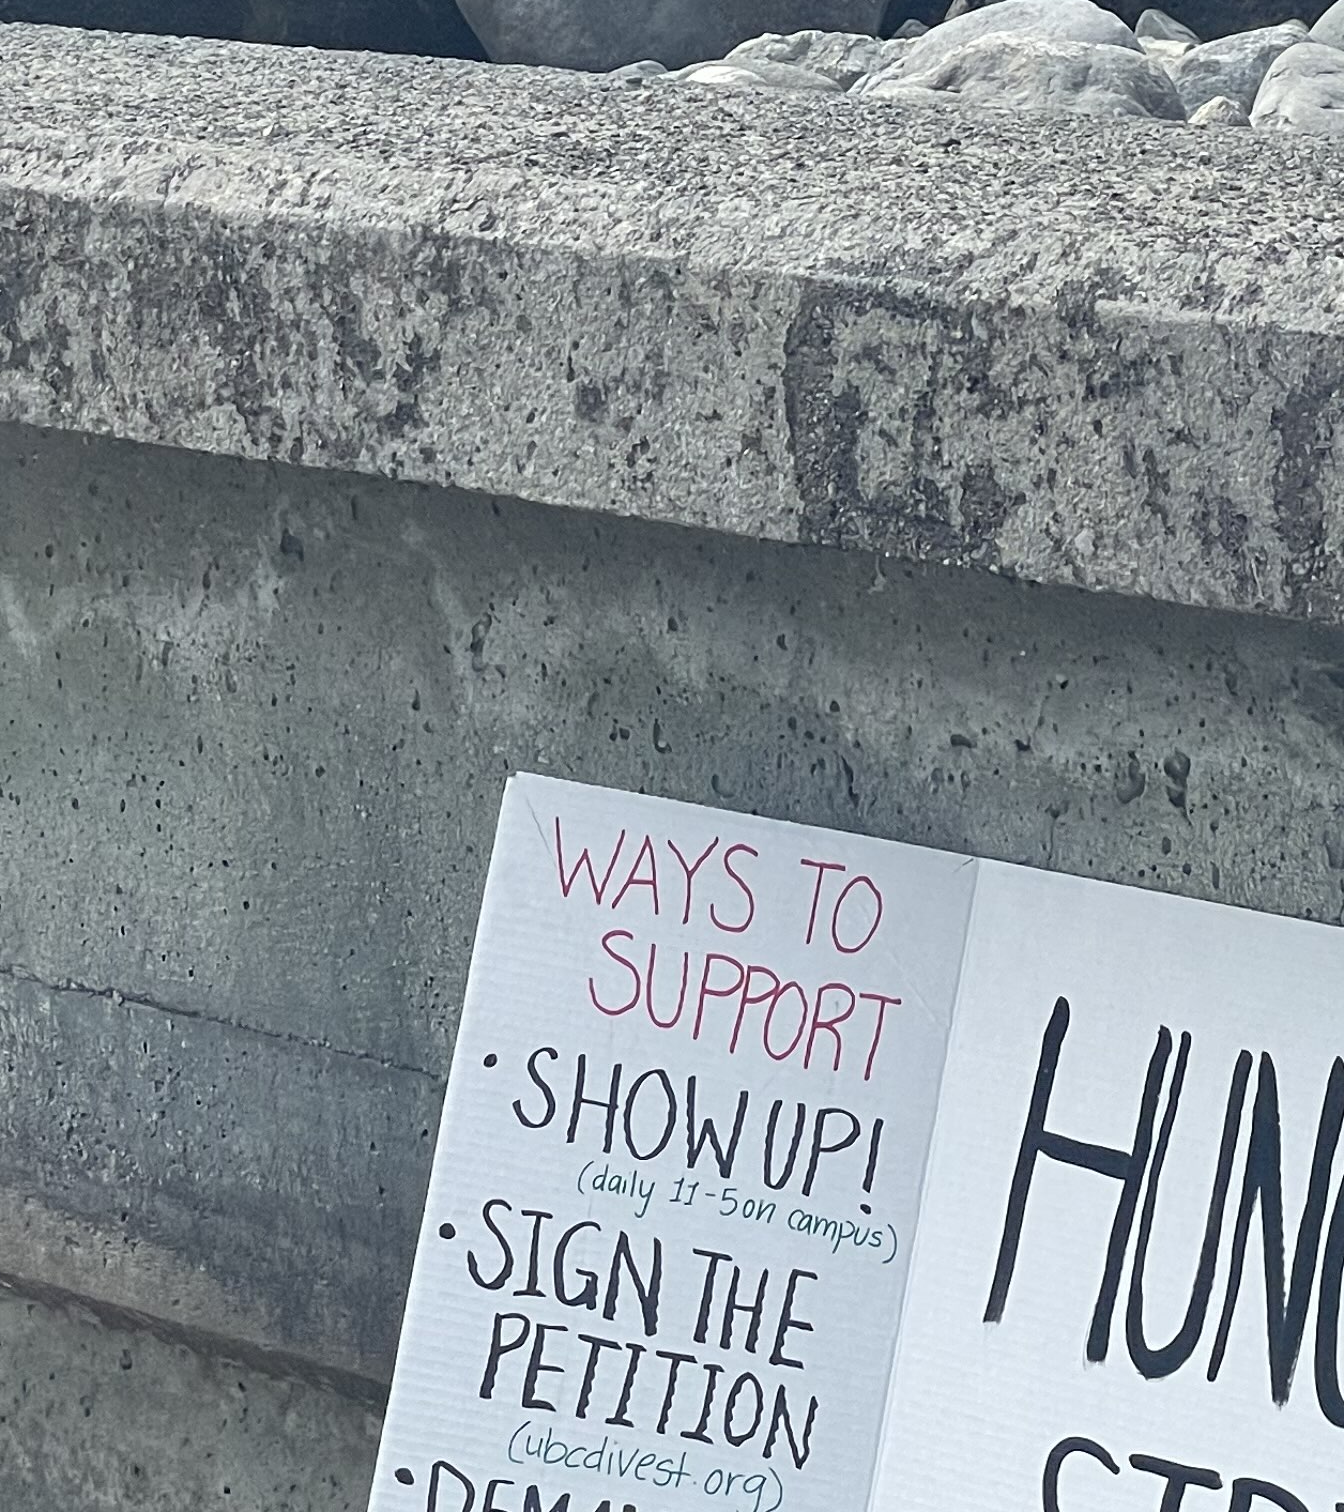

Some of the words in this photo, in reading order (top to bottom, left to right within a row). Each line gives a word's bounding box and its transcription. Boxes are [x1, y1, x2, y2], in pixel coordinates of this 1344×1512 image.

[554, 815, 759, 933] WAYS
[800, 858, 883, 953] TO
[588, 929, 902, 1081] SUPPORT
[512, 1046, 749, 1179] SHOW
[763, 1099, 885, 1215] UP!
[466, 1198, 662, 1336] SIGN
[691, 1247, 818, 1370] THE
[577, 1160, 656, 1218] (daily
[787, 1207, 899, 1265] campus)
[478, 1312, 819, 1470] PETITION
[507, 1421, 783, 1512] (ubcdivest.org)
